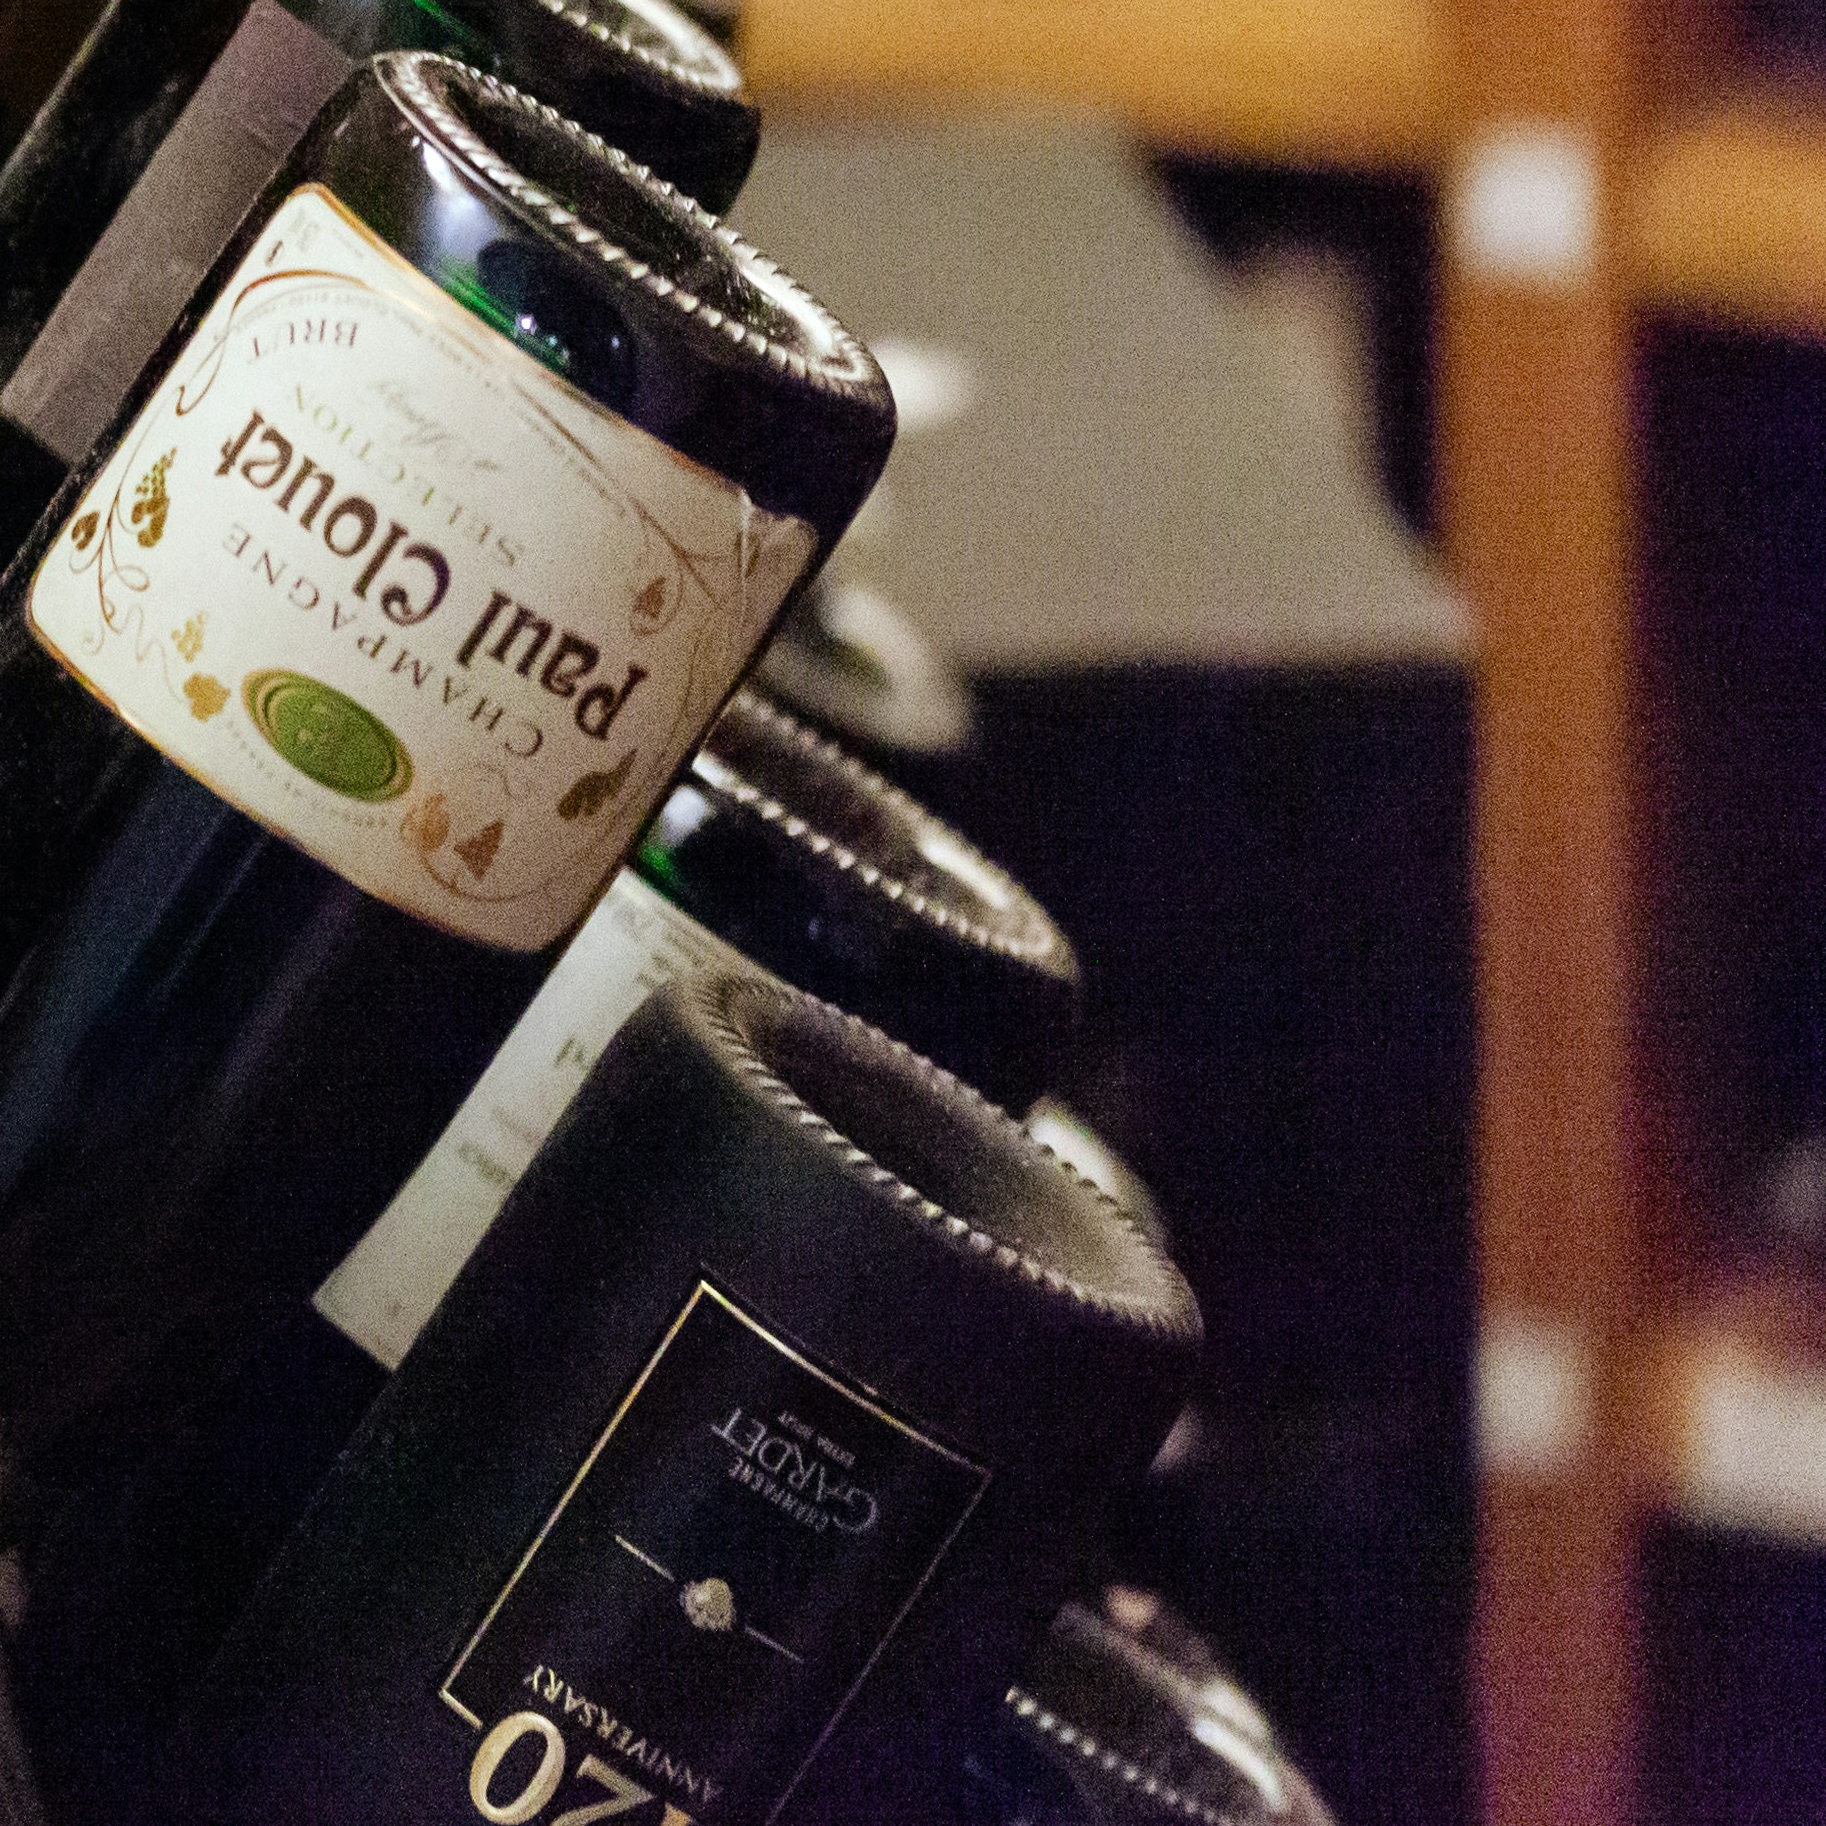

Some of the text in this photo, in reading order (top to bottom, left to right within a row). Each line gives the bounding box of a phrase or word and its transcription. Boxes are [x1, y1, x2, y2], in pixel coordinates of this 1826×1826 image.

[244, 319, 359, 363] BRUT
[212, 409, 451, 626] Clouet
[281, 381, 525, 569] SELECTION
[216, 521, 549, 763] CHAMPAGNE
[452, 588, 651, 739] Paul
[708, 1406, 874, 1532] GARDET
[468, 1711, 697, 1826] 20
[522, 1664, 721, 1804] ANNIVERSARY
